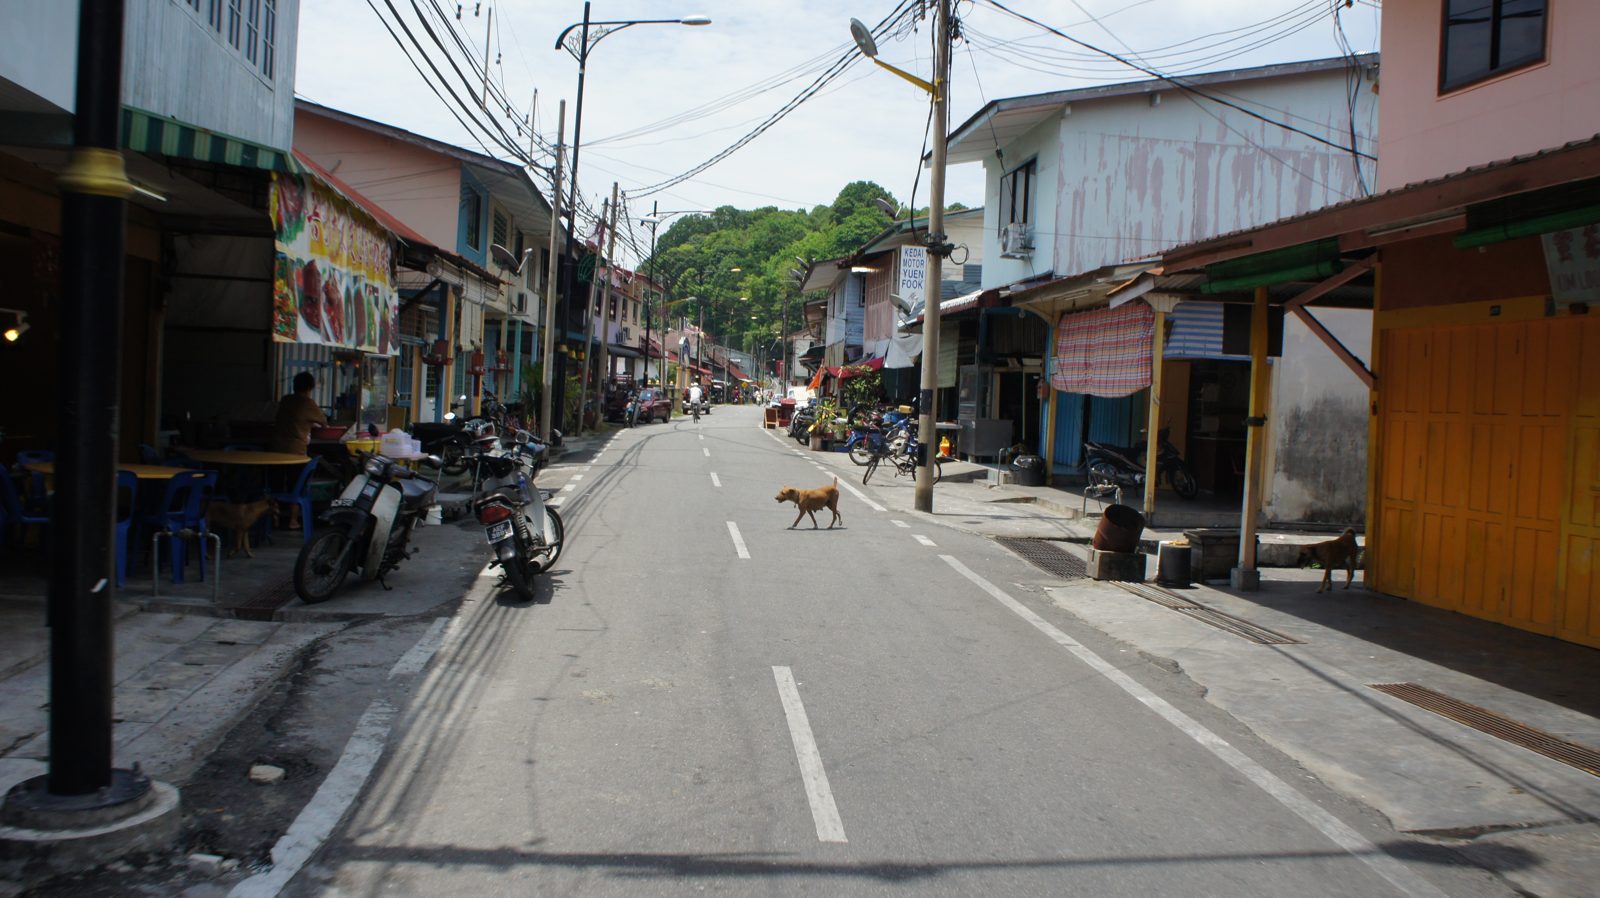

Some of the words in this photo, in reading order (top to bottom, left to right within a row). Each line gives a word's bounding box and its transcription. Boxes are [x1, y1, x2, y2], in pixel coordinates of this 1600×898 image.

[904, 248, 924, 258] KEDAI
[903, 259, 925, 269] MOTOR
[903, 269, 924, 279] YUEN
[901, 279, 923, 289] FOOK
